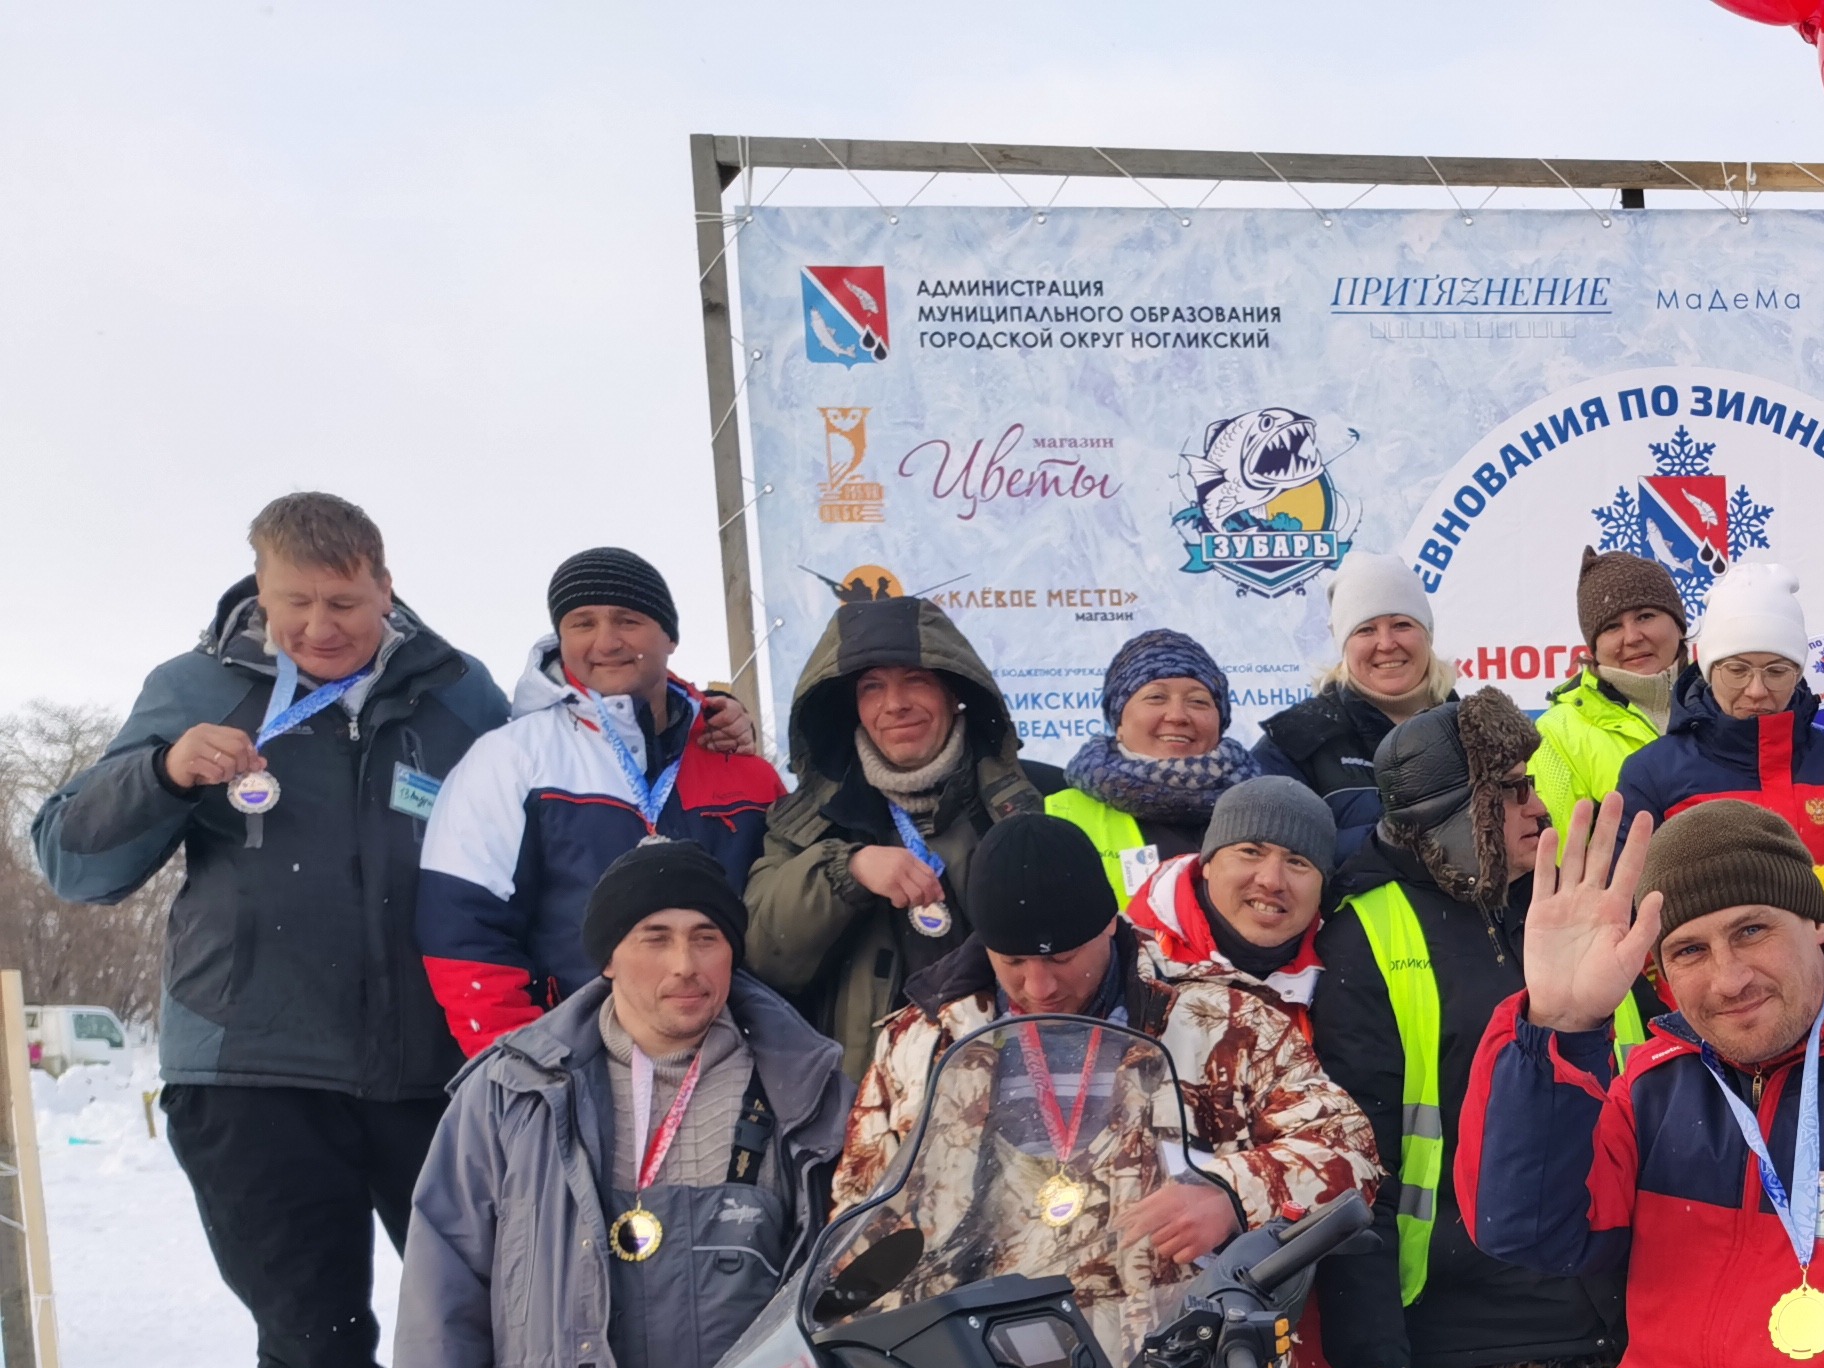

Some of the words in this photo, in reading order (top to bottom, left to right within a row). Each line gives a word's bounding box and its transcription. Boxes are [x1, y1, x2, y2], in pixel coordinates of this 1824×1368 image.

[916, 279, 1104, 299] АДМИНИСТРАЦИЯ
[918, 304, 1124, 324] МУНИЦИПАЛЬНОГО
[1130, 306, 1281, 323] ОБРАЗОВАНИЯ
[919, 325, 1053, 350] ГОРОДСКОЙ
[1060, 331, 1126, 349] ОКРУГ
[1131, 326, 1271, 349] НОГЛИКСКИЙ
[1618, 384, 1679, 422] ПО
[1033, 435, 1115, 450] магазин
[898, 423, 1123, 522] Цветы
[1211, 534, 1332, 560] ЗУБАРЬ
[1047, 588, 1139, 608] МЕСТО»
[1075, 611, 1134, 622] магазин
[1808, 638, 1823, 650] ПО
[1255, 664, 1300, 674] ОБЛАСТИ
